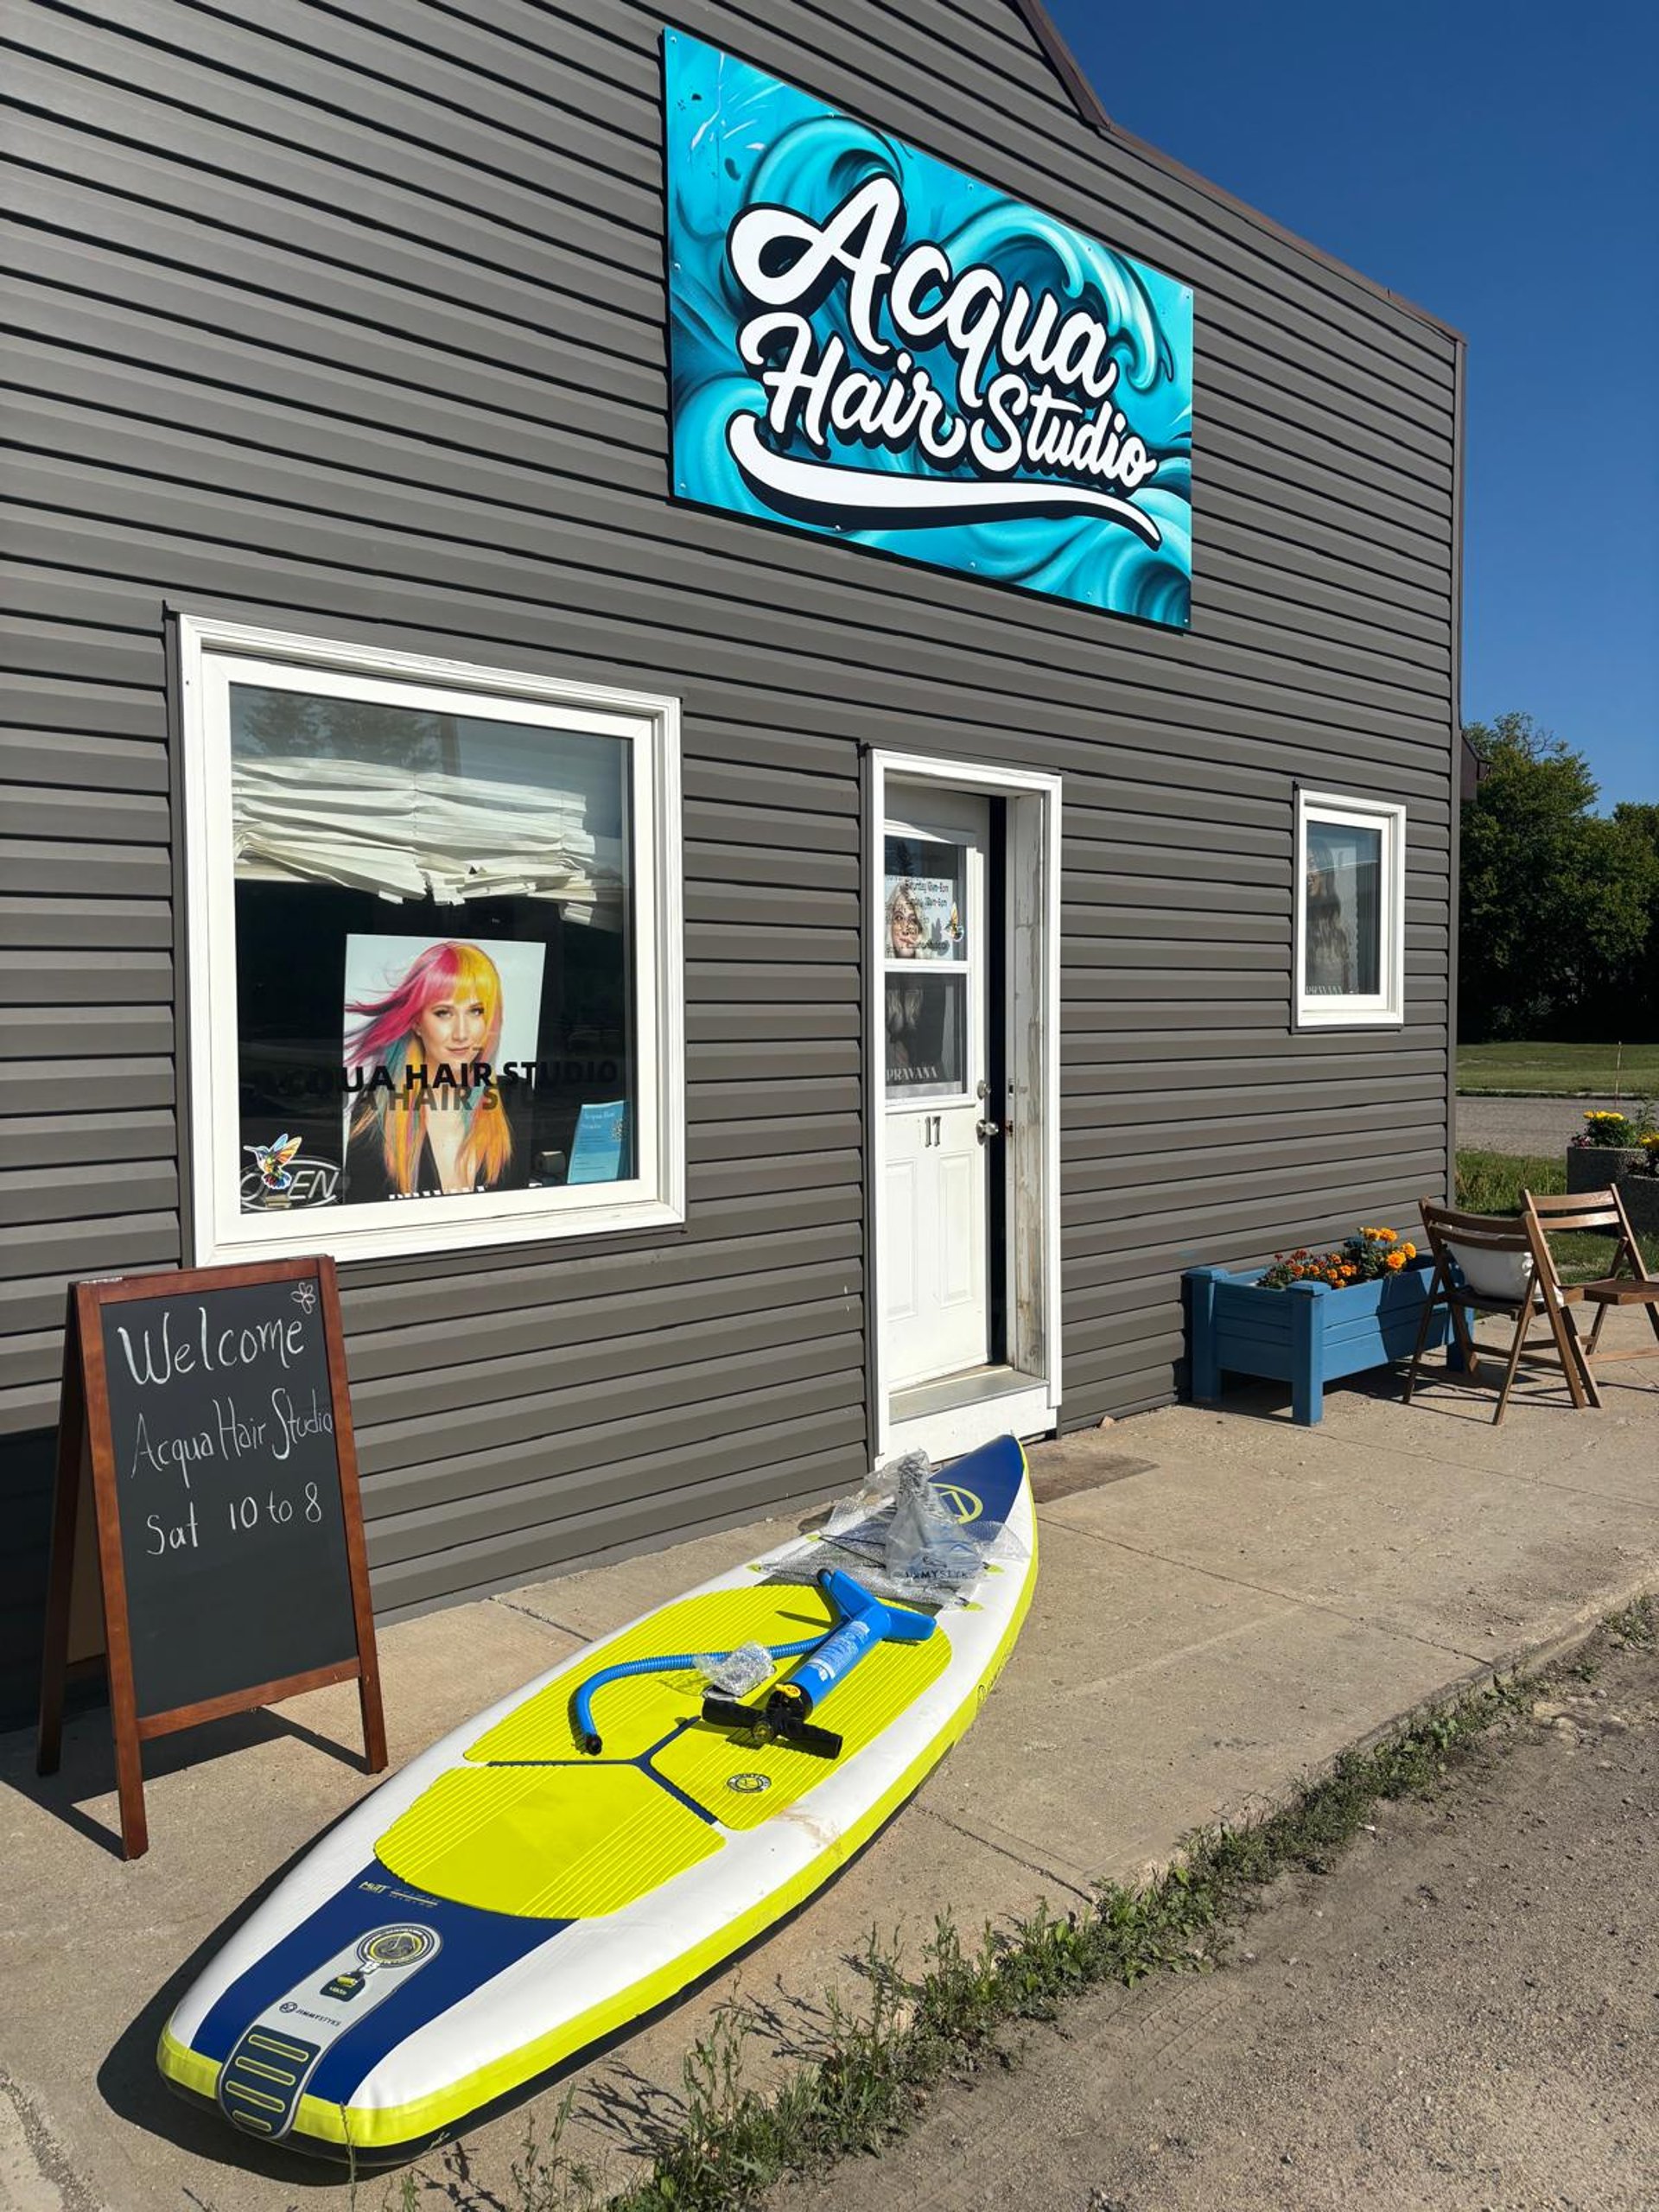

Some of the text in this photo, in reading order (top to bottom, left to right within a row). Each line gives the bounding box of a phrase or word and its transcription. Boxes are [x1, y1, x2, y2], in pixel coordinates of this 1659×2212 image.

[730, 175, 1119, 409] Acqua
[740, 314, 1158, 489] Hair Studio
[405, 1062, 499, 1090] HAIR
[925, 1116, 941, 1147] 17
[240, 1170, 340, 1202] OEN
[118, 1306, 304, 1385] Welcome
[130, 1387, 333, 1489] Acqua Hair Studio
[145, 1481, 322, 1555] Sat 10 to 8
